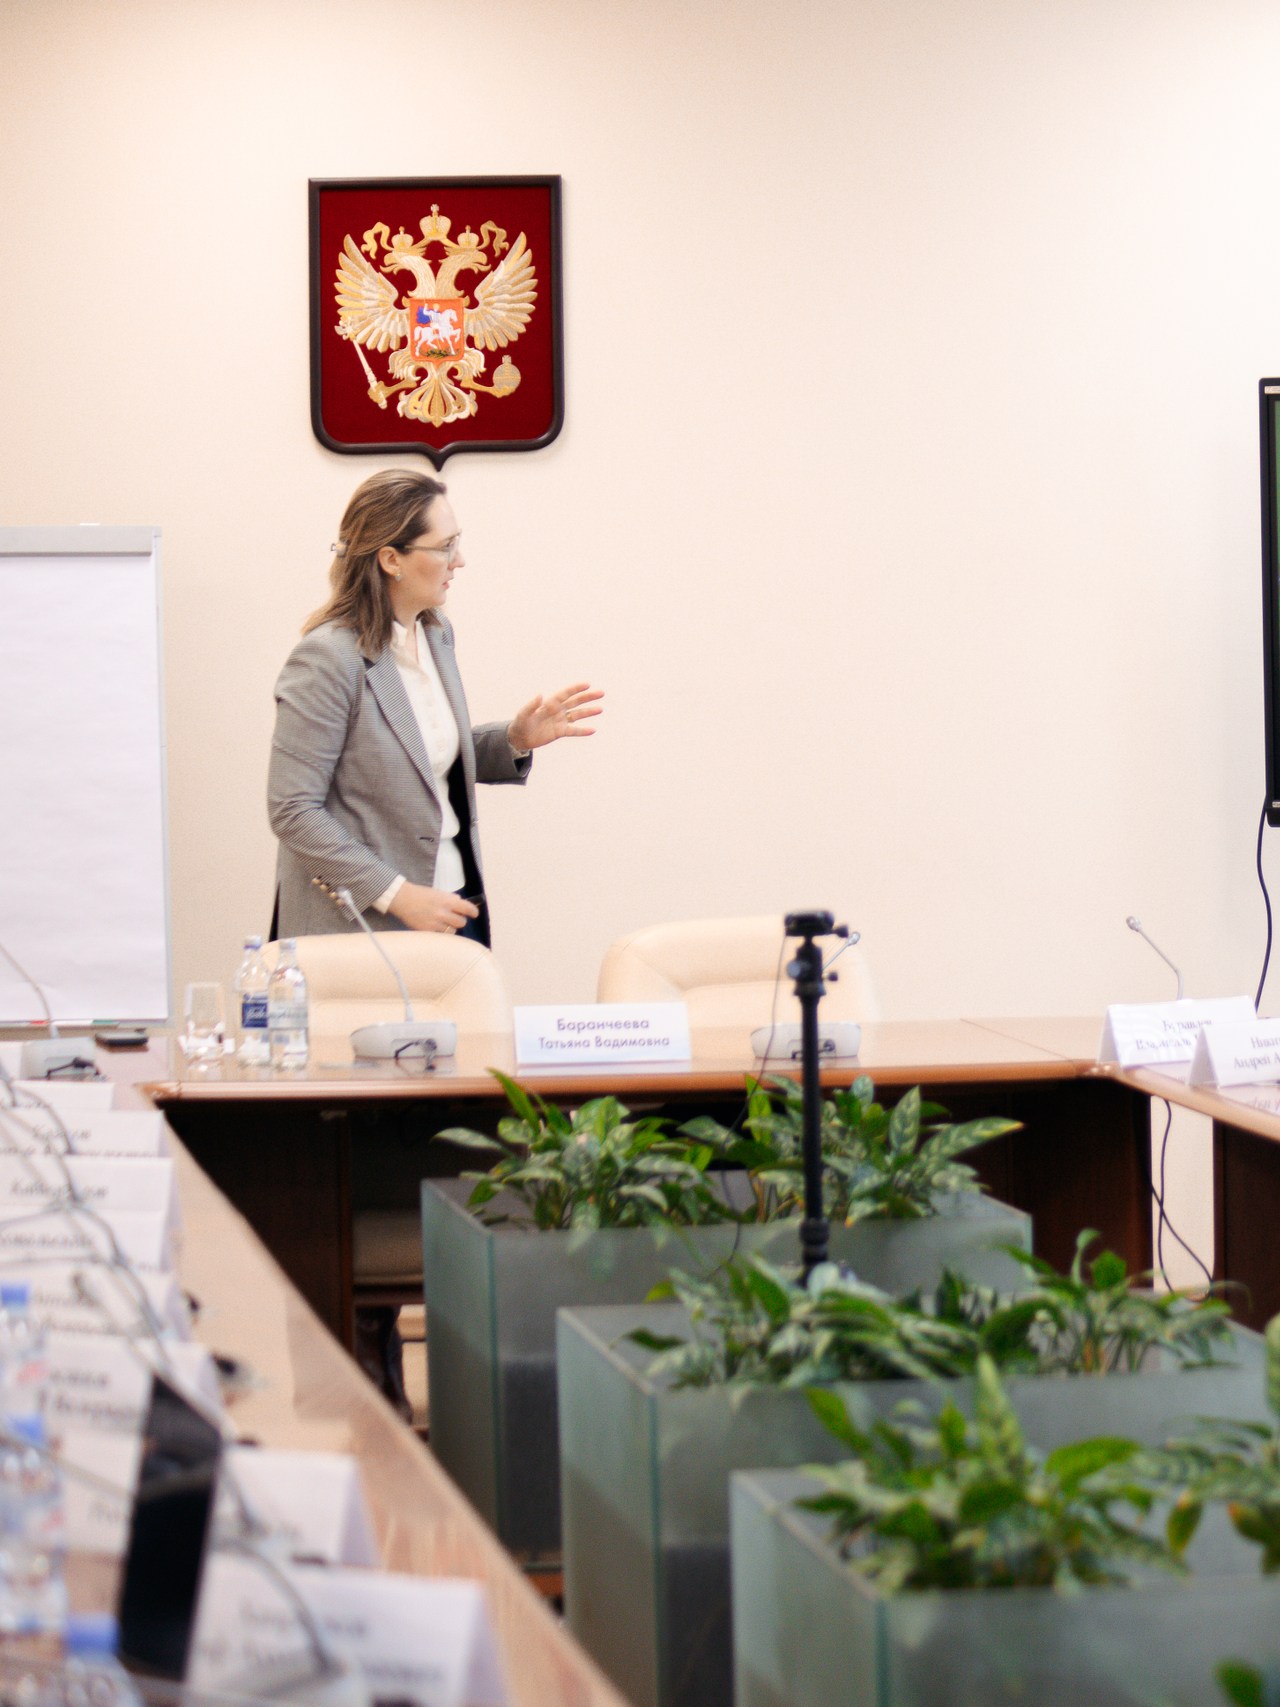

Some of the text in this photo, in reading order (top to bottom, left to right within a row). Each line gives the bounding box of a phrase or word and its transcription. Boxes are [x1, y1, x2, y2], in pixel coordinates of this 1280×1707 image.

[557, 1018, 650, 1034] Баранчеева
[538, 1035, 670, 1050] Татьяна Вадимовна
